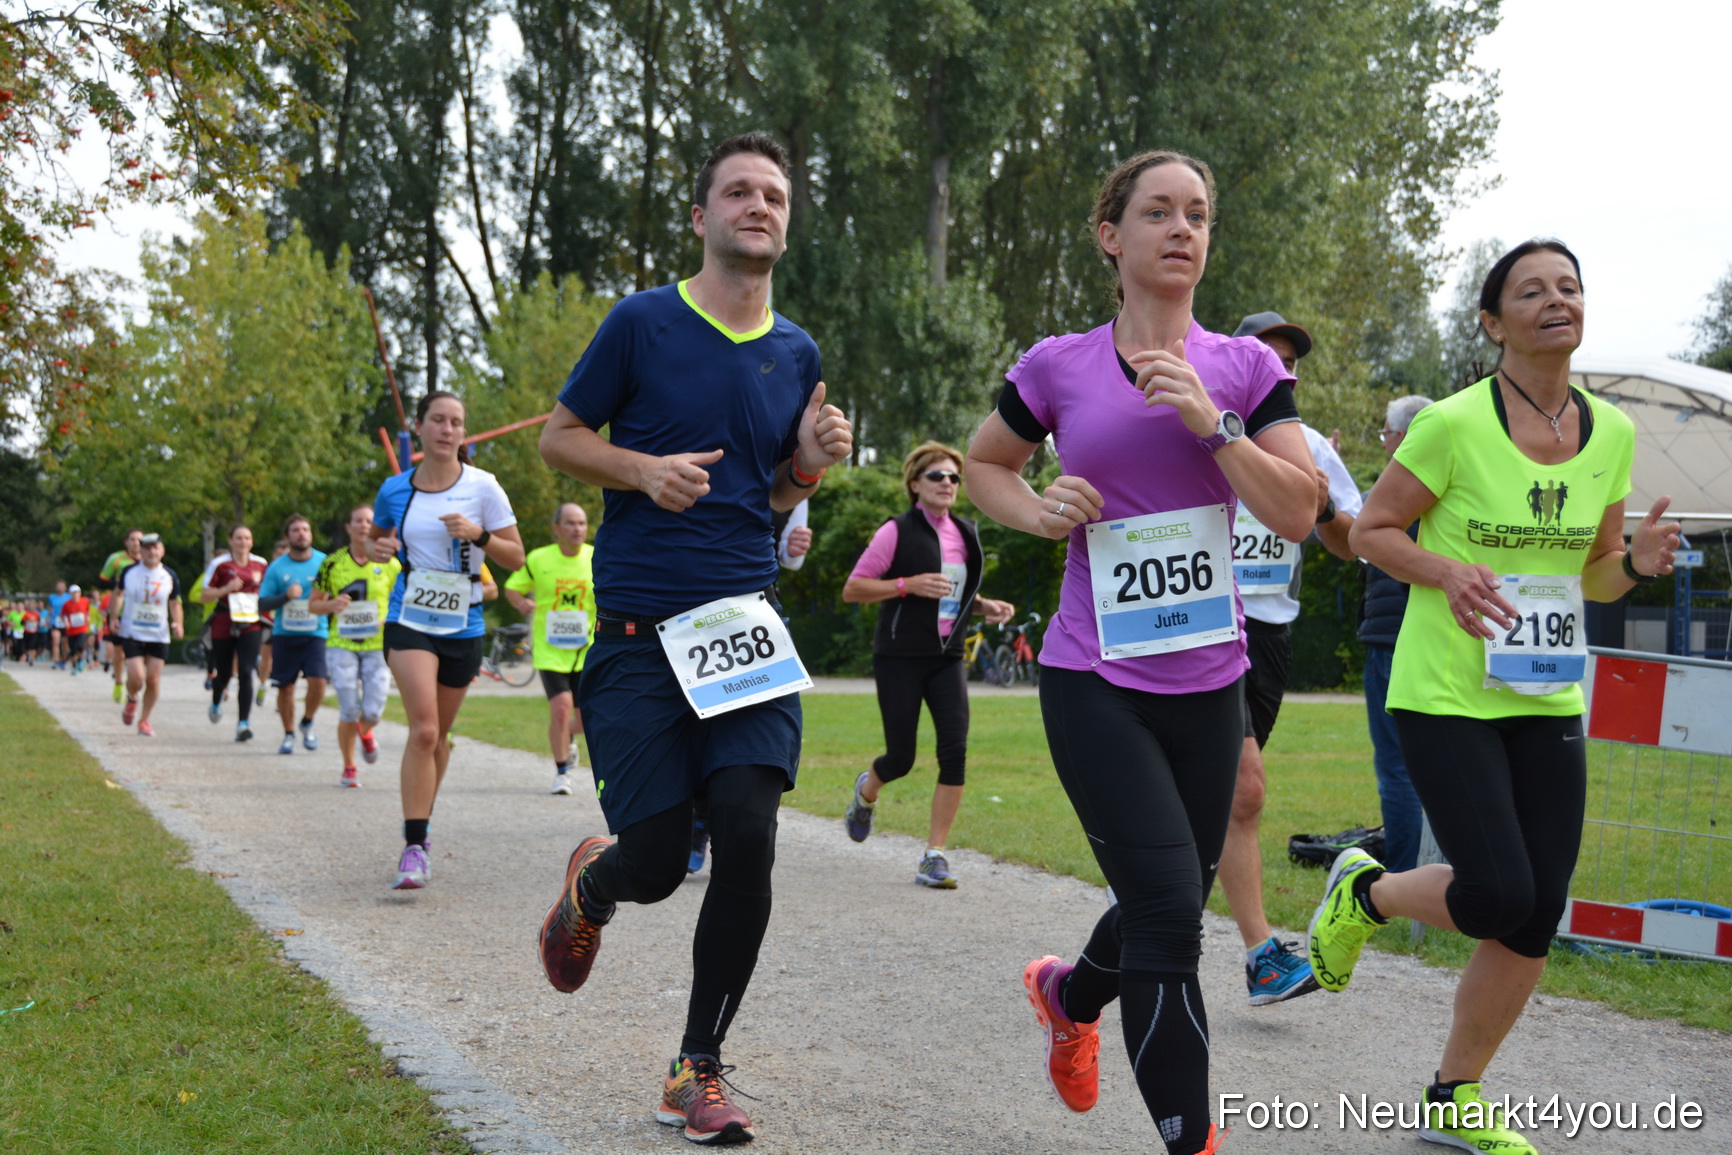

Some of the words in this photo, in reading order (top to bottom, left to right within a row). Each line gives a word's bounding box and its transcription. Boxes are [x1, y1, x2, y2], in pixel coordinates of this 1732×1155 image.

[1141, 522, 1192, 540] BOCK
[1467, 518, 1492, 532] SC
[1232, 534, 1284, 559] 2245
[1113, 550, 1213, 603] 2056
[1243, 569, 1271, 579] Roland
[413, 587, 460, 610] 2226
[1529, 585, 1567, 596] BOCK
[1102, 600, 1108, 609] C
[705, 607, 745, 625] BOCK
[1154, 612, 1189, 629] Jutta
[1504, 612, 1575, 647] 2196
[688, 626, 775, 679] 2358
[1531, 660, 1557, 674] Ilona
[722, 673, 770, 695] Mathias
[1311, 936, 1352, 986] BROO
